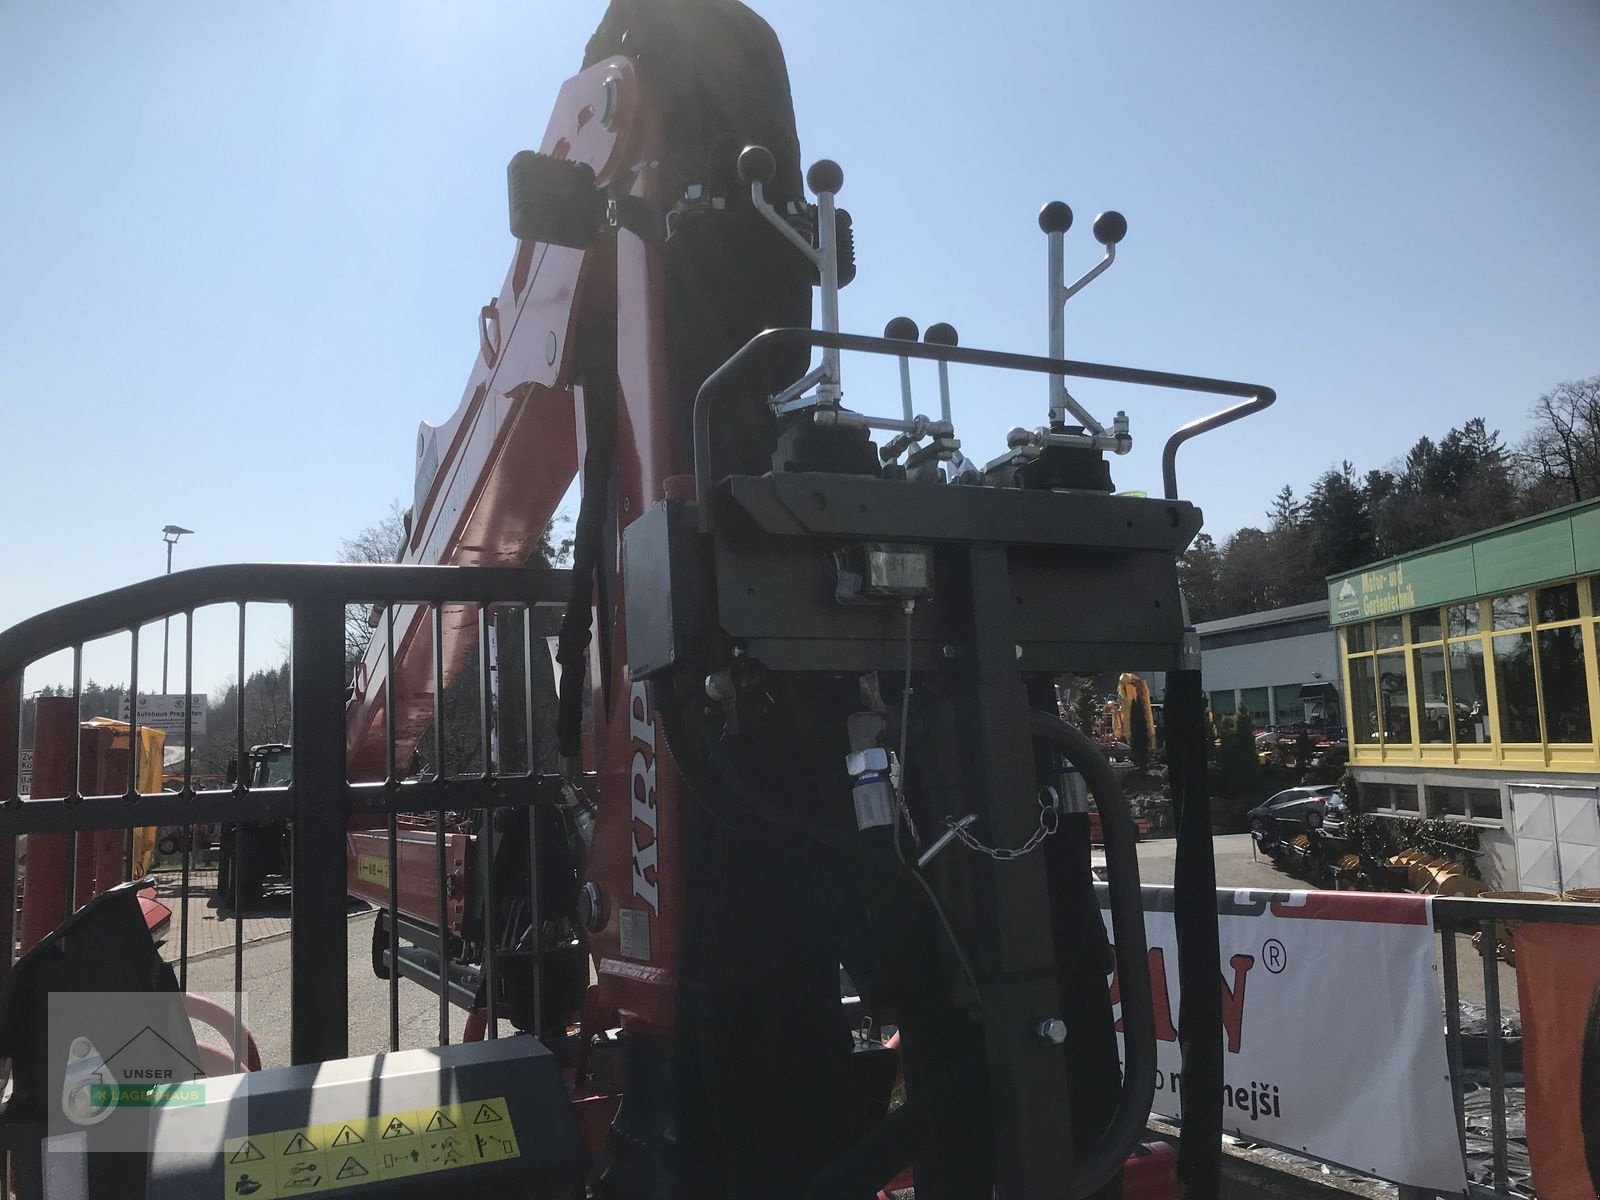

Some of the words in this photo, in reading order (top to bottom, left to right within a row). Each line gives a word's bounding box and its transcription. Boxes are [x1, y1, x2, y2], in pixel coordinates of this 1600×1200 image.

[1361, 571, 1387, 594] Motor-
[1388, 562, 1404, 588] und
[1363, 583, 1416, 617] Gartentechnik
[136, 710, 168, 718] Autohaus
[169, 710, 203, 718] Pregten
